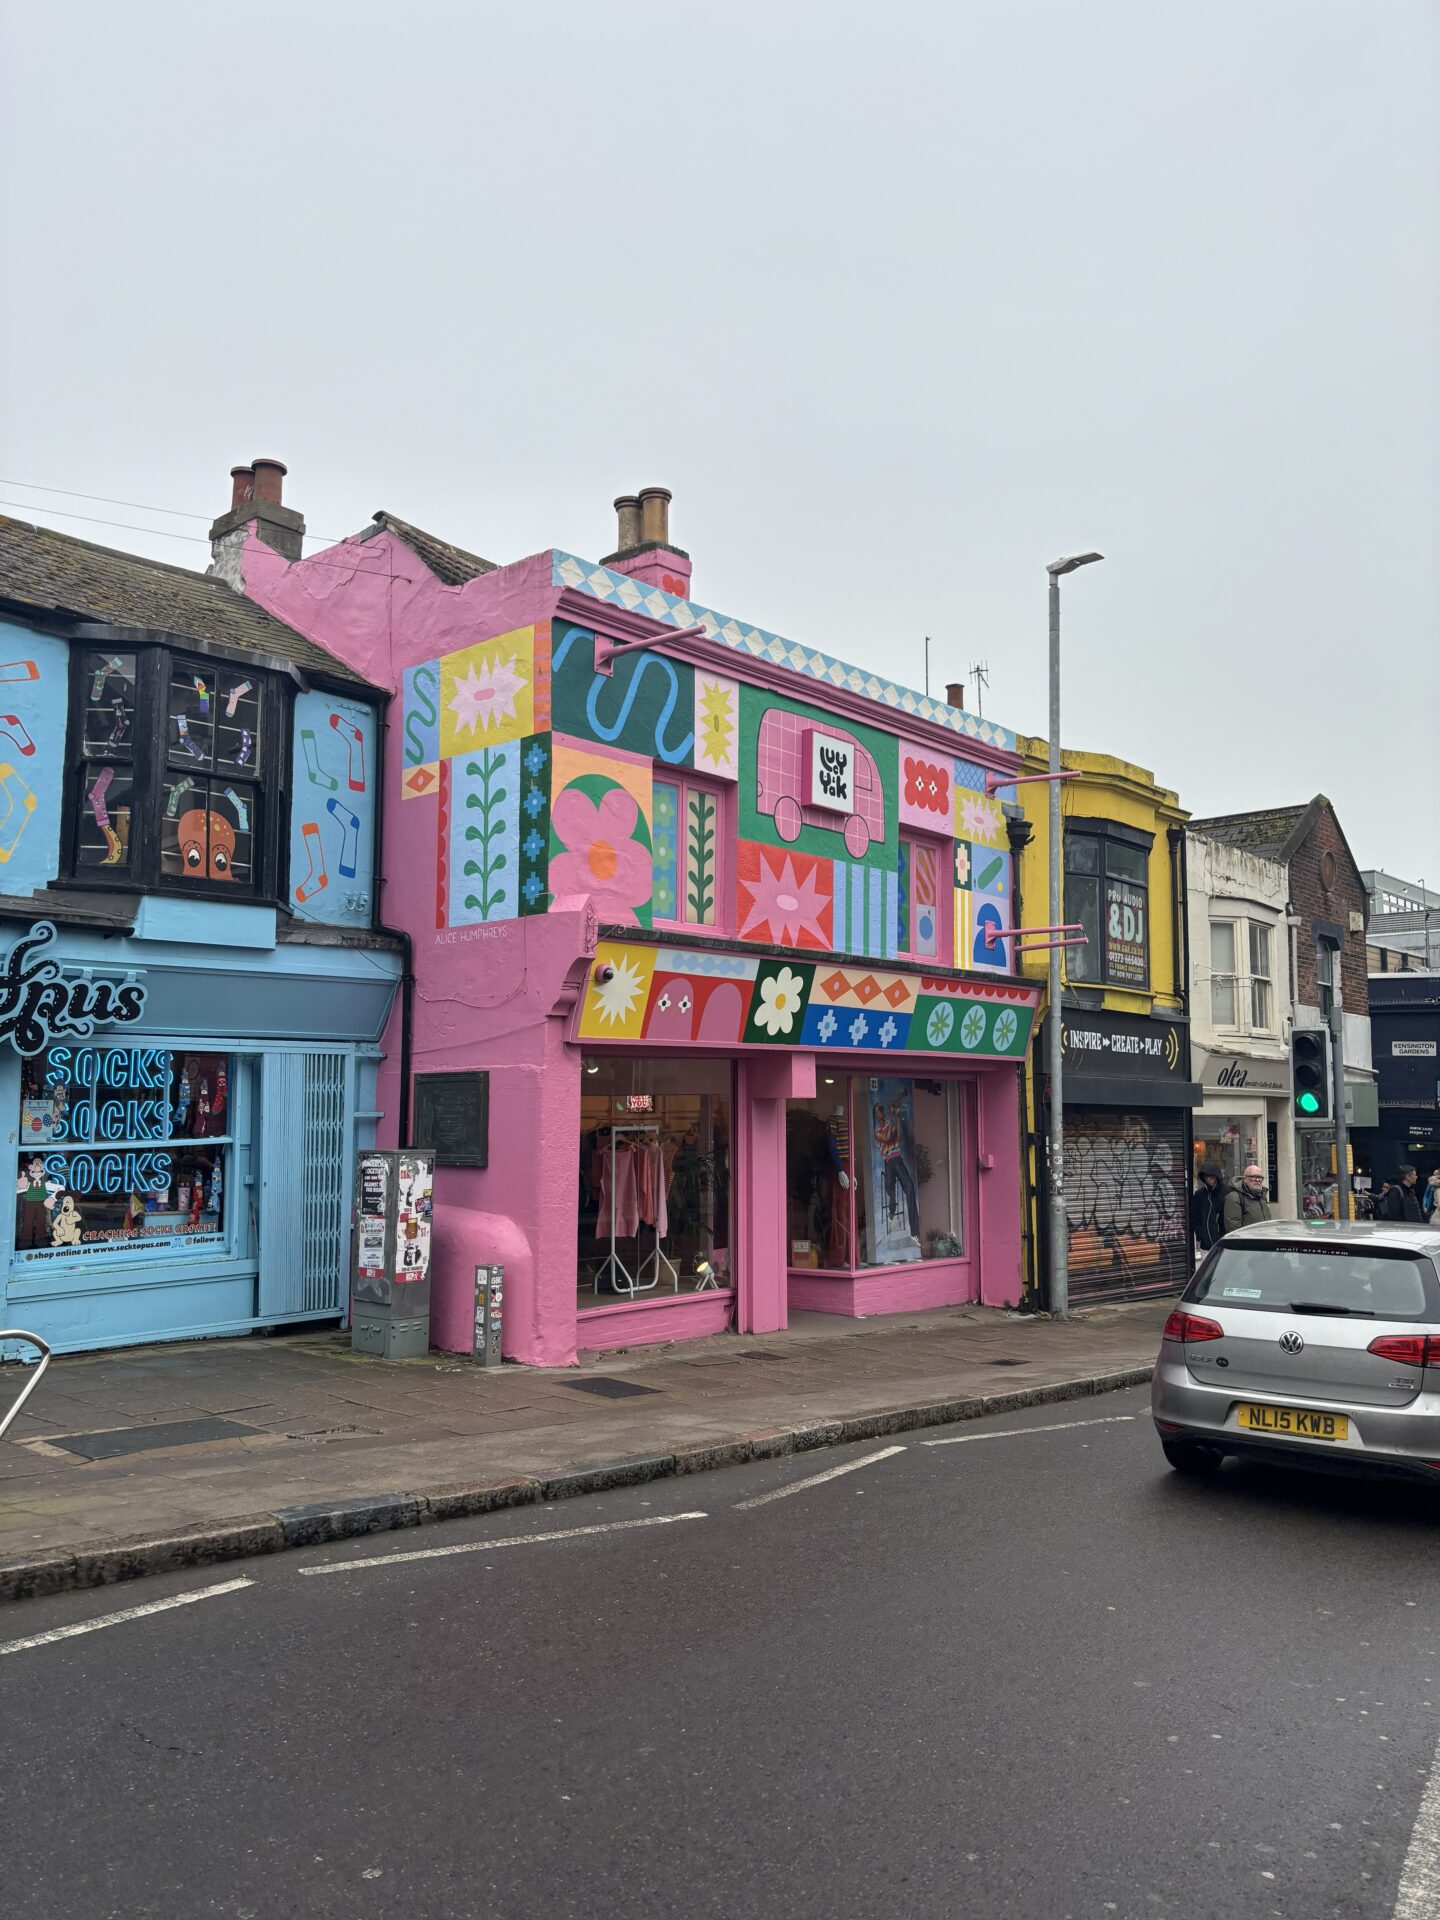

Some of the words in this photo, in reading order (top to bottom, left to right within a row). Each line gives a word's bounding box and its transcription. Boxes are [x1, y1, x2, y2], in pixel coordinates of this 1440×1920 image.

[1108, 889, 1121, 902] PRO
[1123, 894, 1143, 908] AUDIO
[435, 931, 457, 944] ALICE
[460, 925, 508, 942] HUMPHREYS
[1109, 951, 1124, 963] 01273
[1070, 1030, 1101, 1050] INSPIRE
[1111, 1034, 1139, 1053] CREATE
[1145, 1038, 1162, 1055] PLAY
[47, 1047, 174, 1088] SOCKS
[1217, 1060, 1248, 1087] olea
[45, 1153, 172, 1194] SOCKS
[140, 1223, 173, 1237] SOCKS
[193, 1236, 216, 1244] follow
[34, 1251, 54, 1260] shop
[55, 1248, 81, 1257] online
[82, 1247, 91, 1255] at
[93, 1240, 171, 1254] www.socktopus.com
[1249, 1407, 1292, 1430] NL15
[1296, 1413, 1335, 1435] KWB
